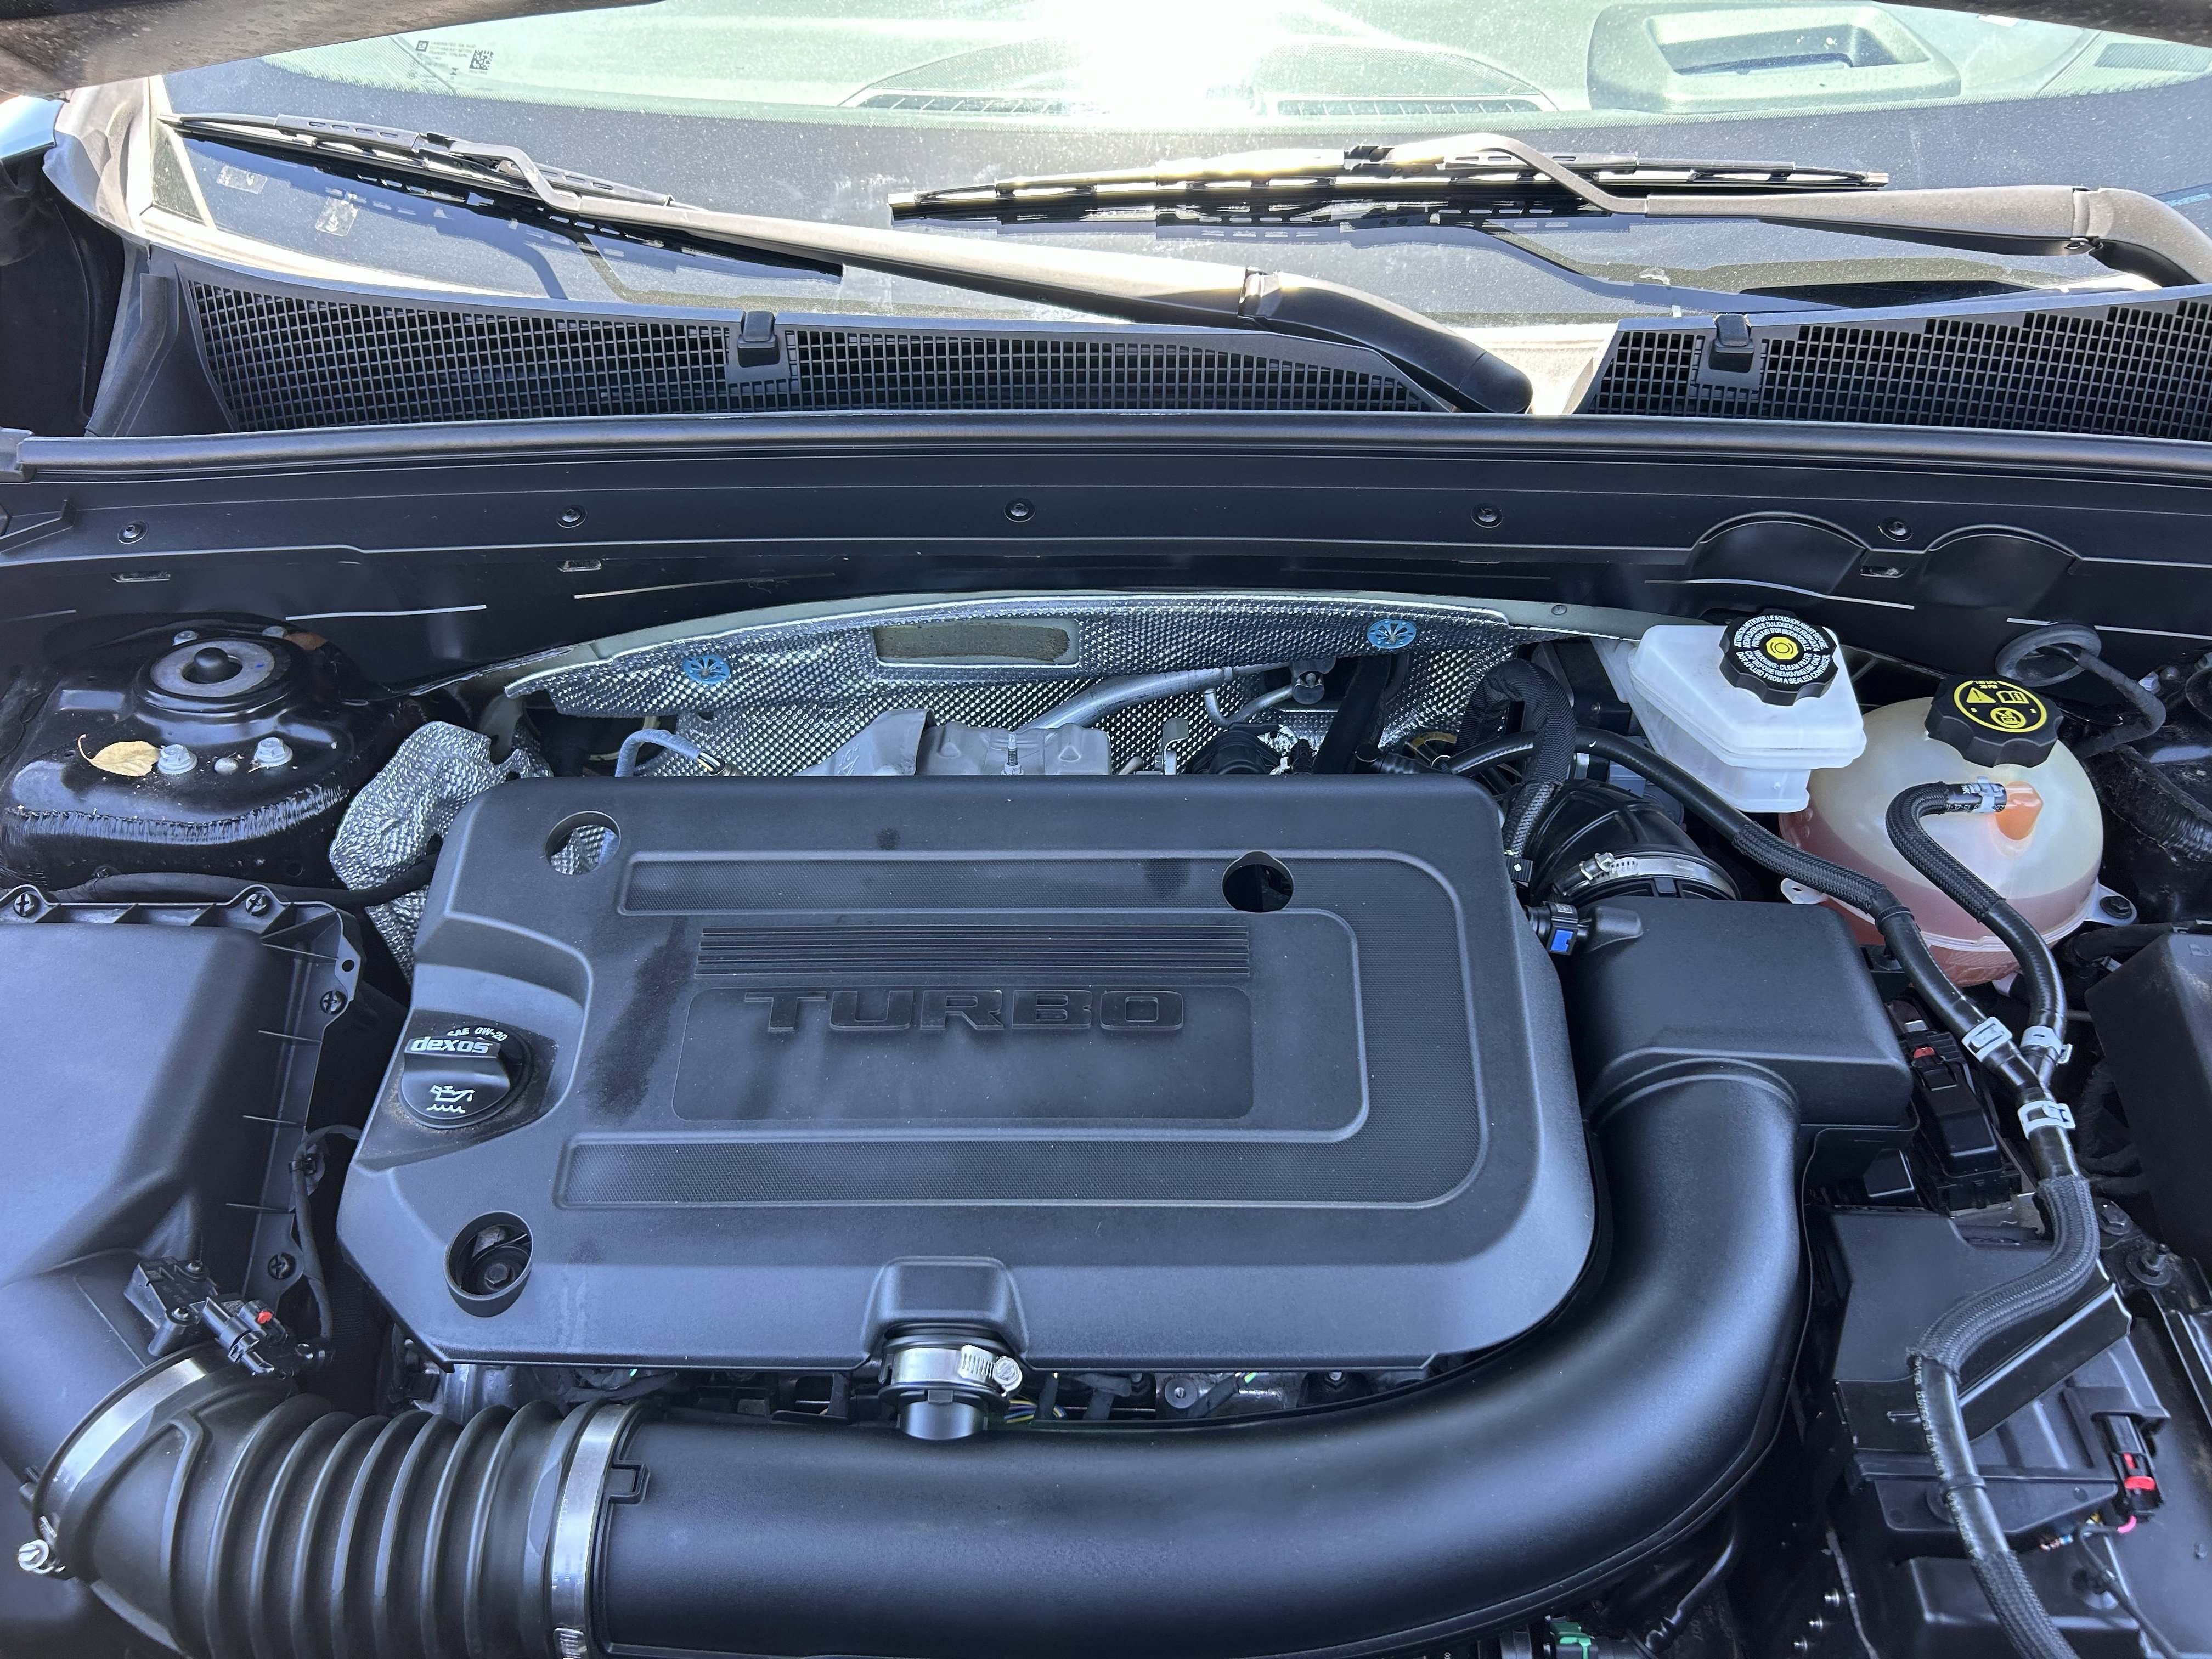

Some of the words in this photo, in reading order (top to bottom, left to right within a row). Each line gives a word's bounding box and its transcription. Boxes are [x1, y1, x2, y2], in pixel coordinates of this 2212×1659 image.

[1773, 621, 1794, 629] LIQUIDE
[1774, 615, 1801, 625] BOUCHON
[1798, 621, 1817, 634] AVANT
[1745, 651, 1757, 661] CAP
[1751, 659, 1775, 674] BEFORE
[1803, 663, 1816, 673] USE
[1810, 653, 1820, 667] ONLY
[1797, 652, 1812, 668] FILLER
[1746, 663, 1764, 676] FLUID
[1762, 673, 1782, 683] FROM
[1788, 674, 1814, 684] SEALED
[743, 989, 1184, 1031] TURBO
[447, 1028, 470, 1036] SAE
[475, 1027, 508, 1041] 0W-20
[411, 1036, 493, 1054] dexos
